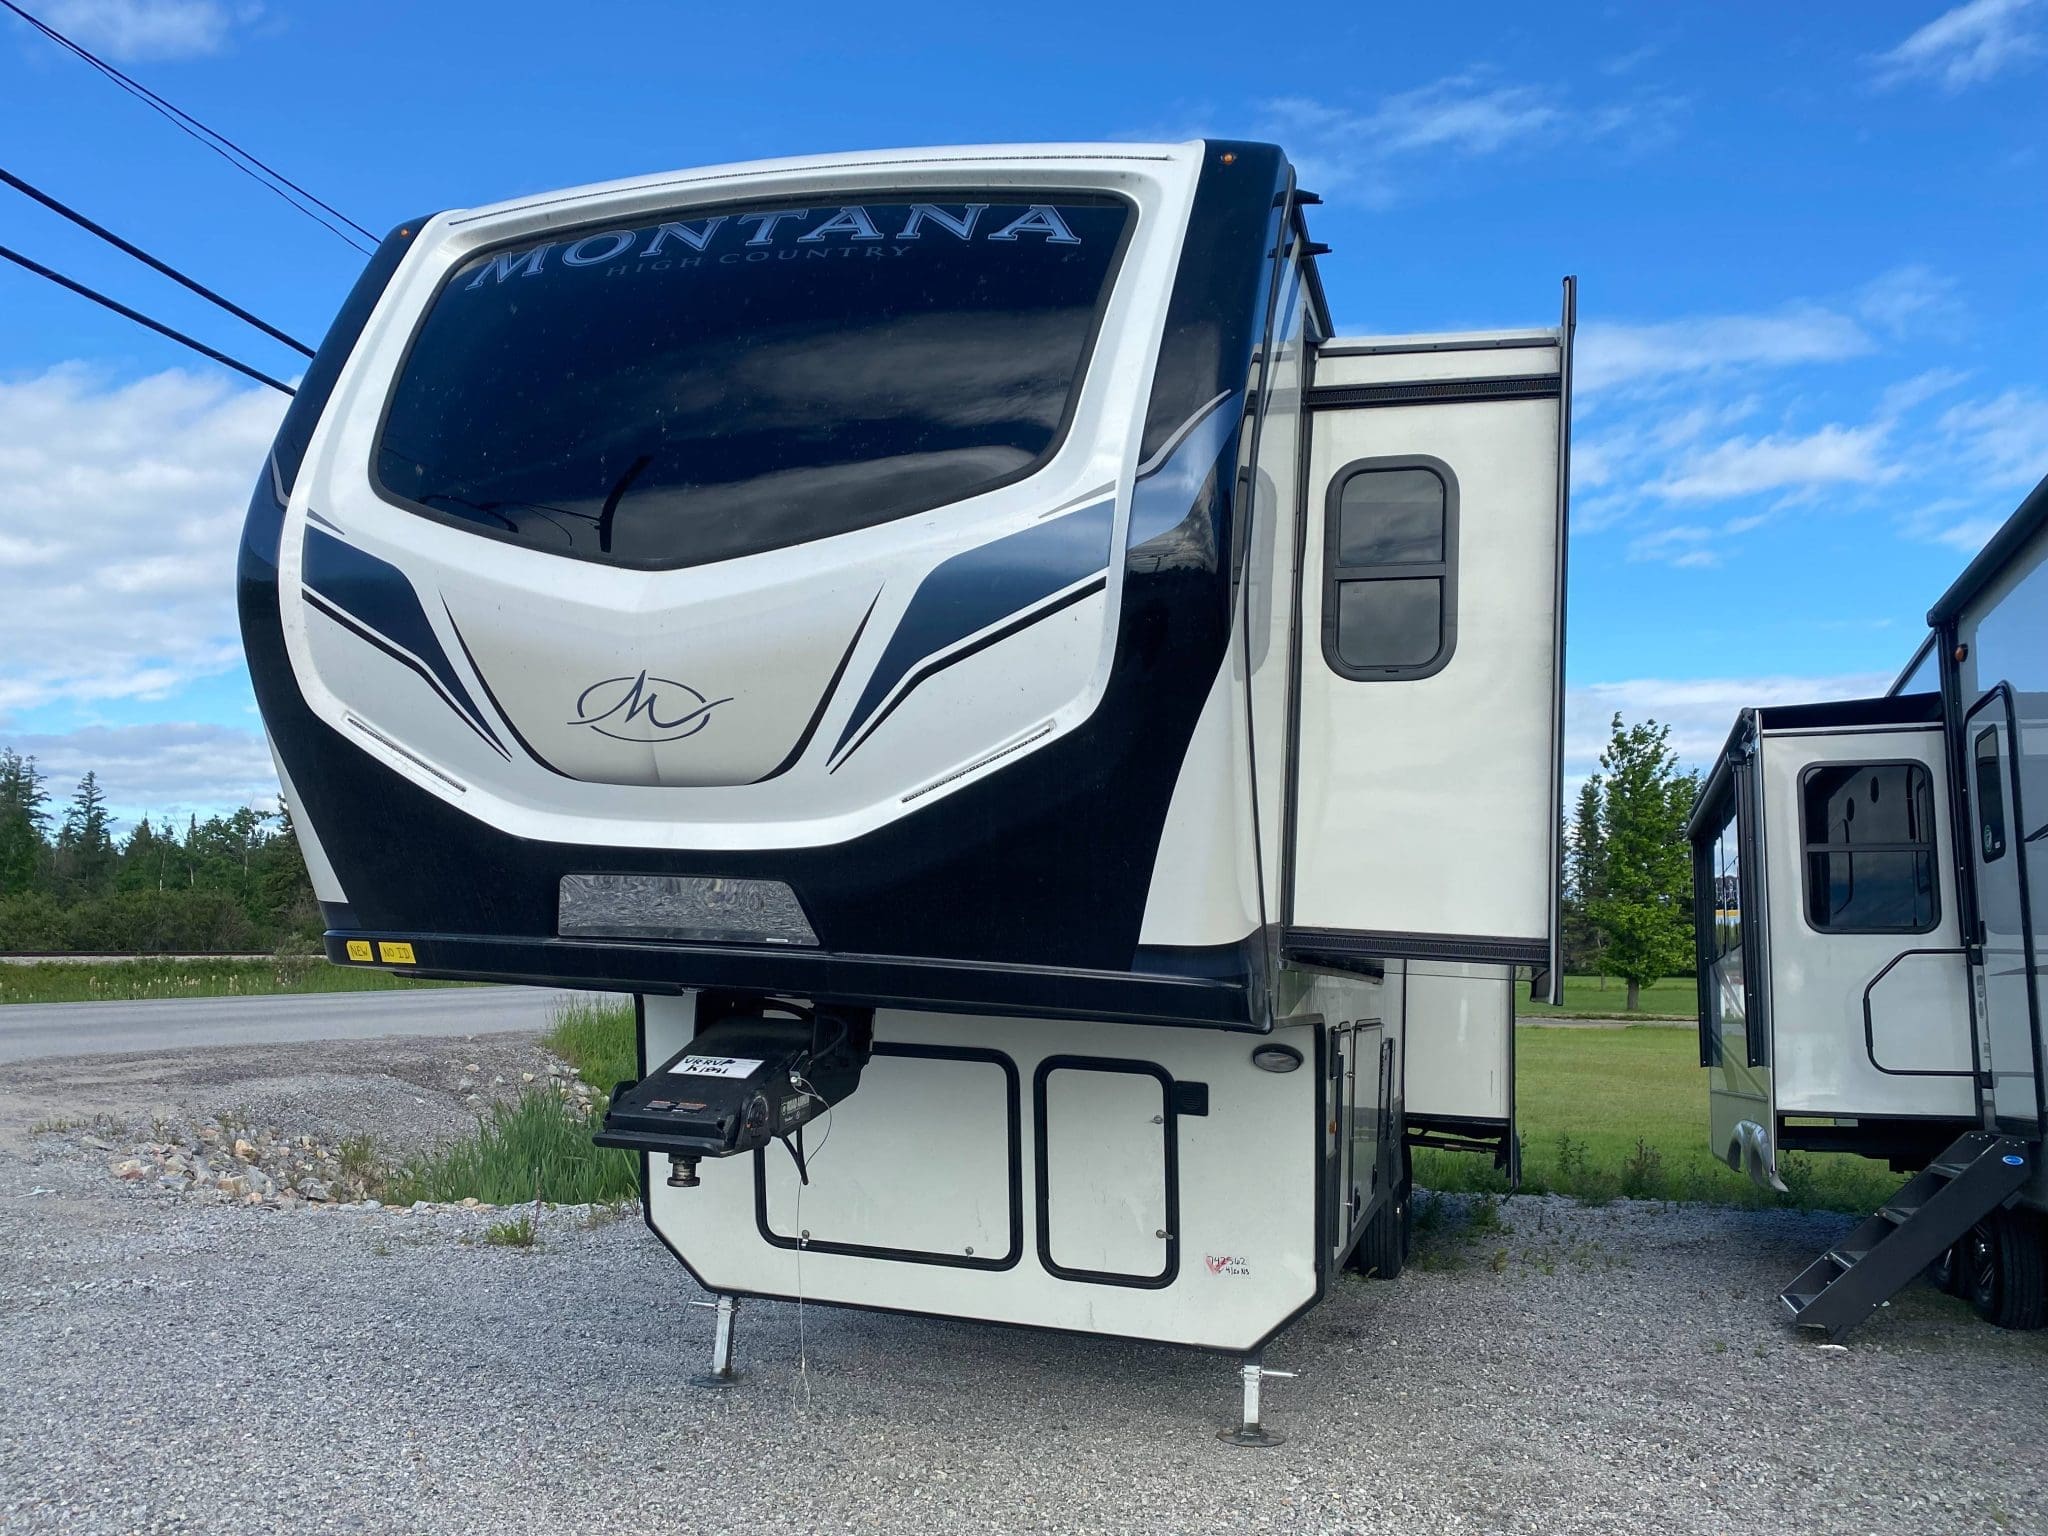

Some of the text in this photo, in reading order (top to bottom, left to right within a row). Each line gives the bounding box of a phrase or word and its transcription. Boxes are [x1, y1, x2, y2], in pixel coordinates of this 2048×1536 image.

[465, 203, 1082, 291] MONTANA
[605, 245, 912, 277] HIGH COUNTRY
[350, 944, 368, 957] NEW
